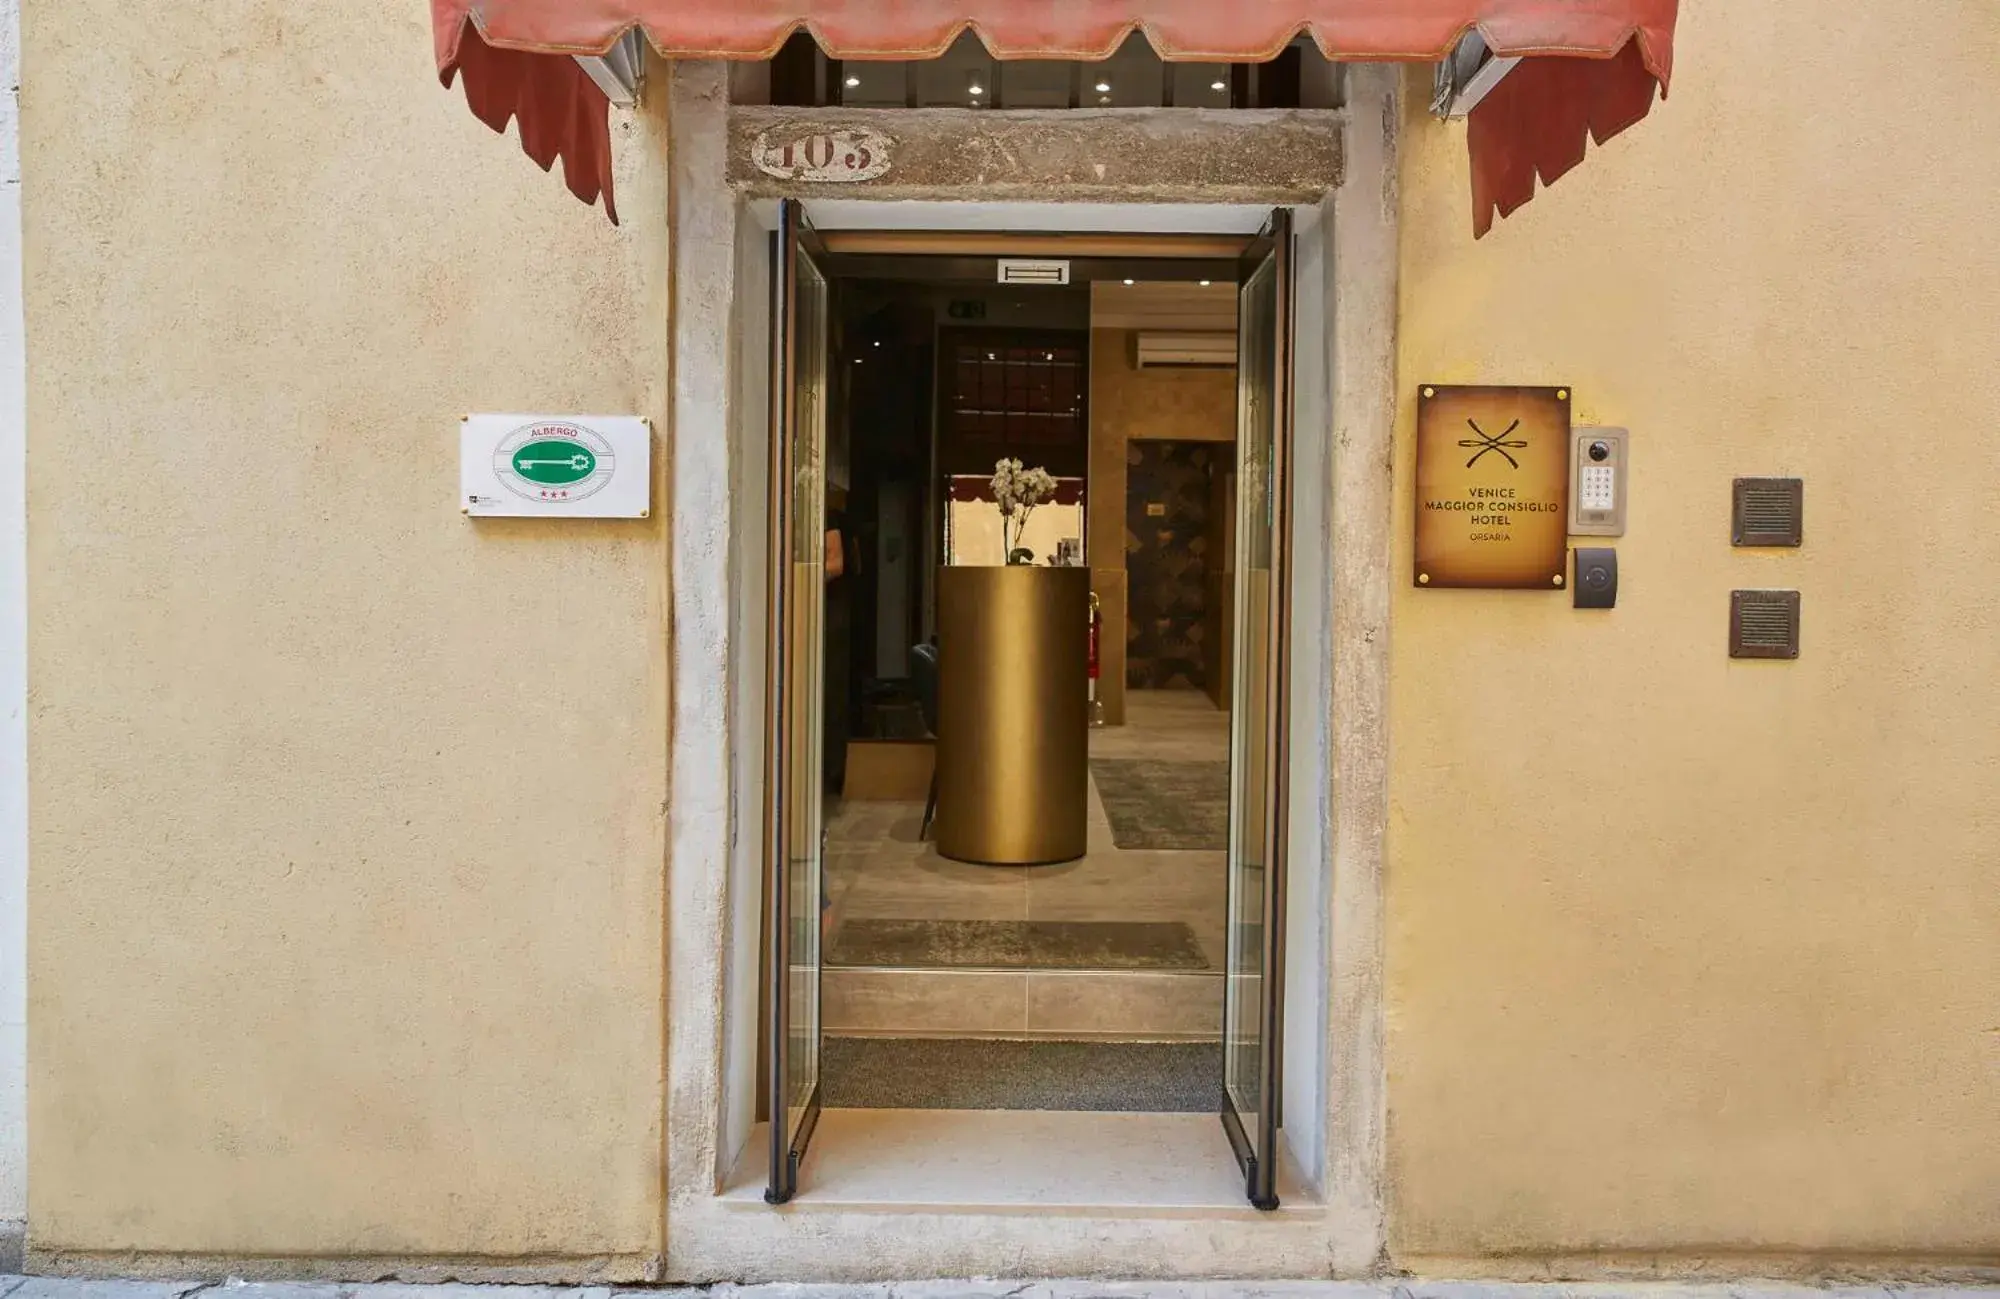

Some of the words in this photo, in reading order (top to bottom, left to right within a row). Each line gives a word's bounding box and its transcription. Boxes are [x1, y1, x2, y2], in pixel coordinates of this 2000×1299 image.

[531, 426, 578, 438] ALBERGO
[1469, 488, 1515, 498] VENICE
[1424, 501, 1484, 512] MAGGIOR
[1488, 502, 1559, 512] CONSIGLIO
[1471, 515, 1511, 525] HOTEL
[1470, 532, 1511, 541] ORSARIA
